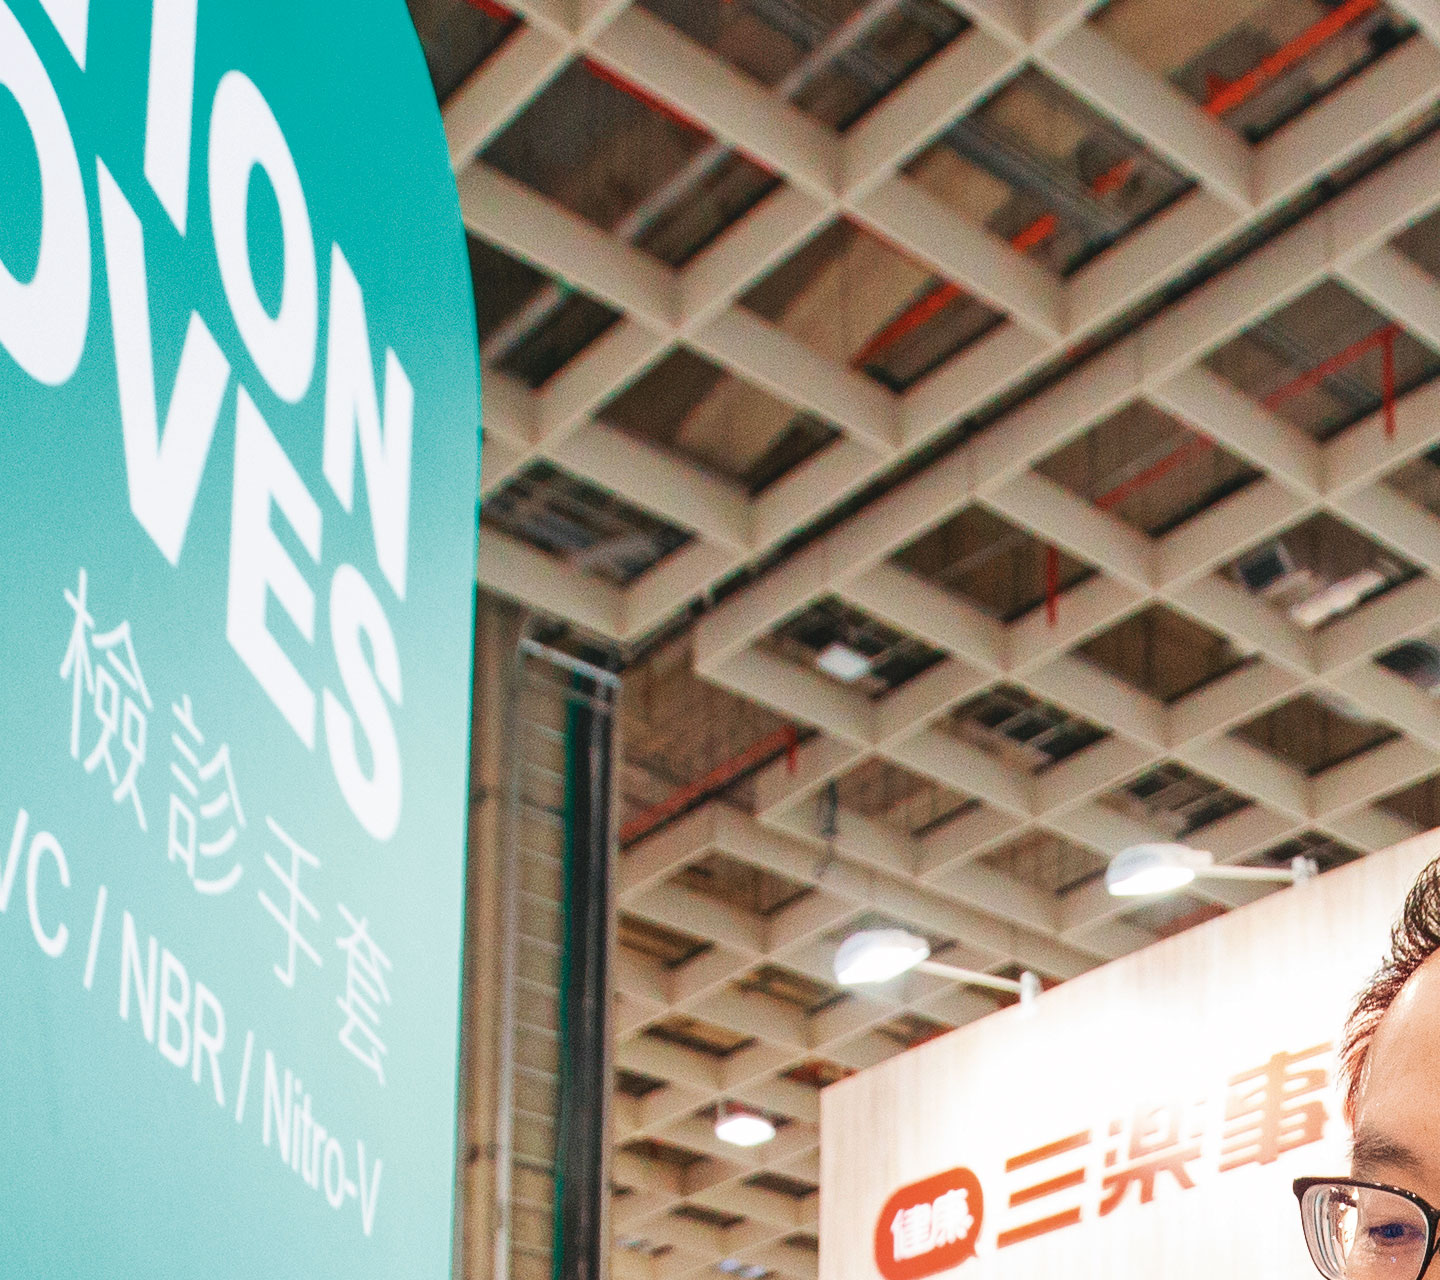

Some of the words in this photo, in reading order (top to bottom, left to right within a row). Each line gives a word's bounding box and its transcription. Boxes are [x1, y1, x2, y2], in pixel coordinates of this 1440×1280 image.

[60, 568, 392, 1085] 檢診手套
[119, 910, 225, 1107] NBR
[262, 1048, 382, 1236] Nitro-V
